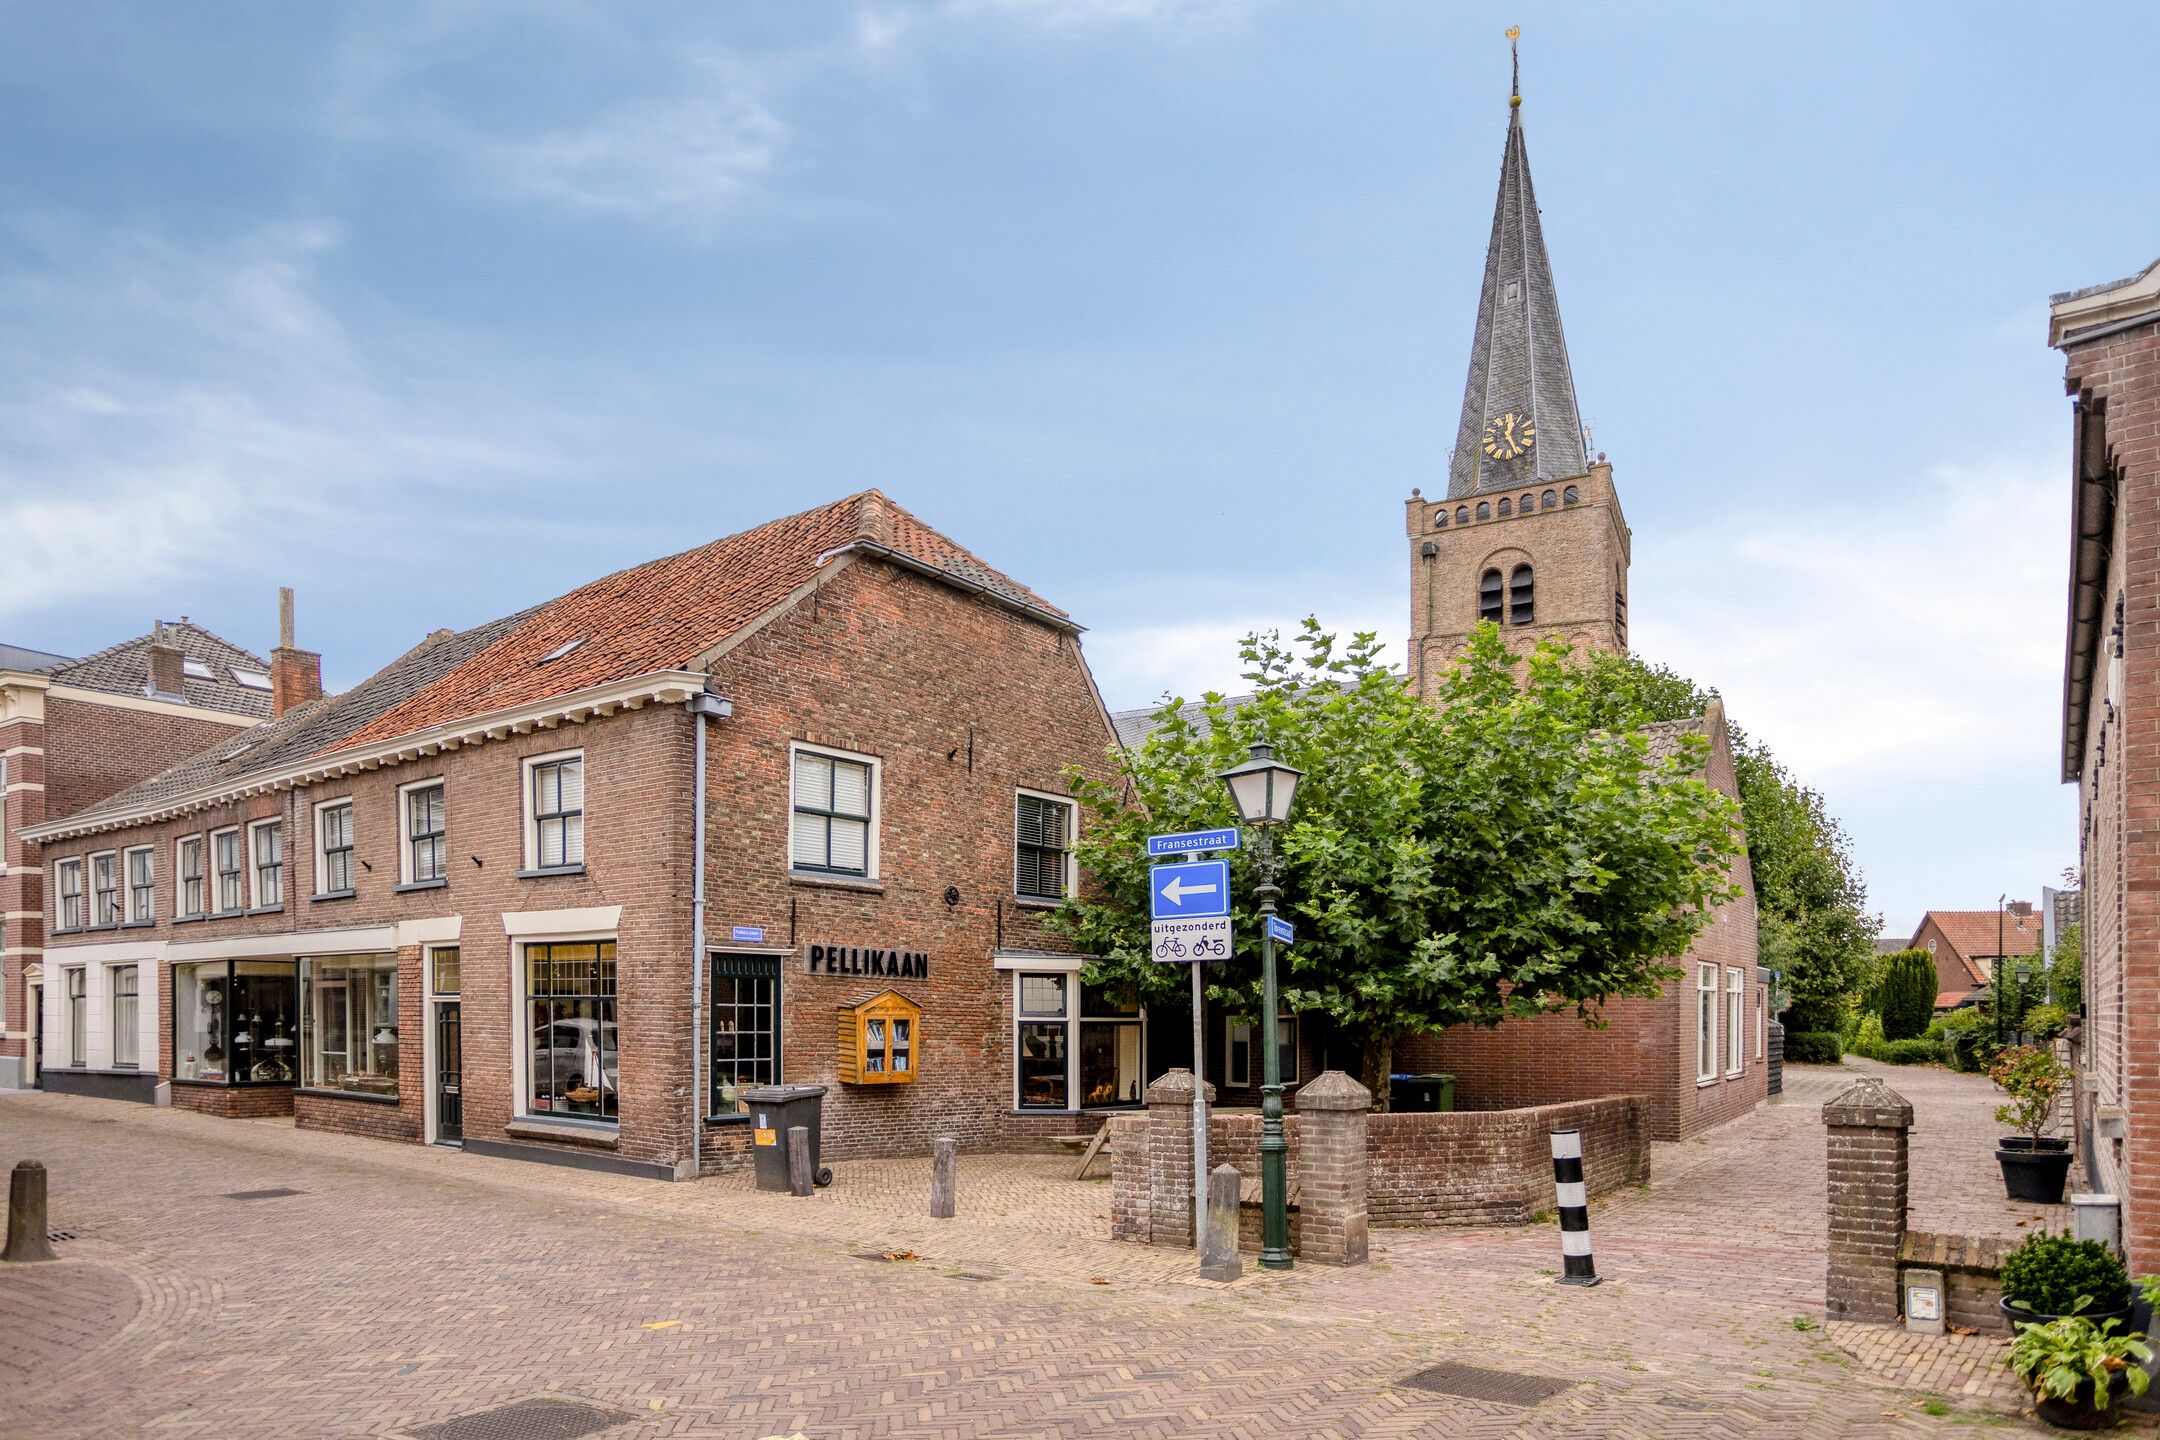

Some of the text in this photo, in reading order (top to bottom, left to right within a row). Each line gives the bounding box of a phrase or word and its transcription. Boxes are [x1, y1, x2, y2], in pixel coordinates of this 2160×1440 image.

[1157, 834, 1227, 850] Fransestraat
[1154, 920, 1227, 935] uitgezonderd
[811, 945, 928, 978] PELLIKAAN
